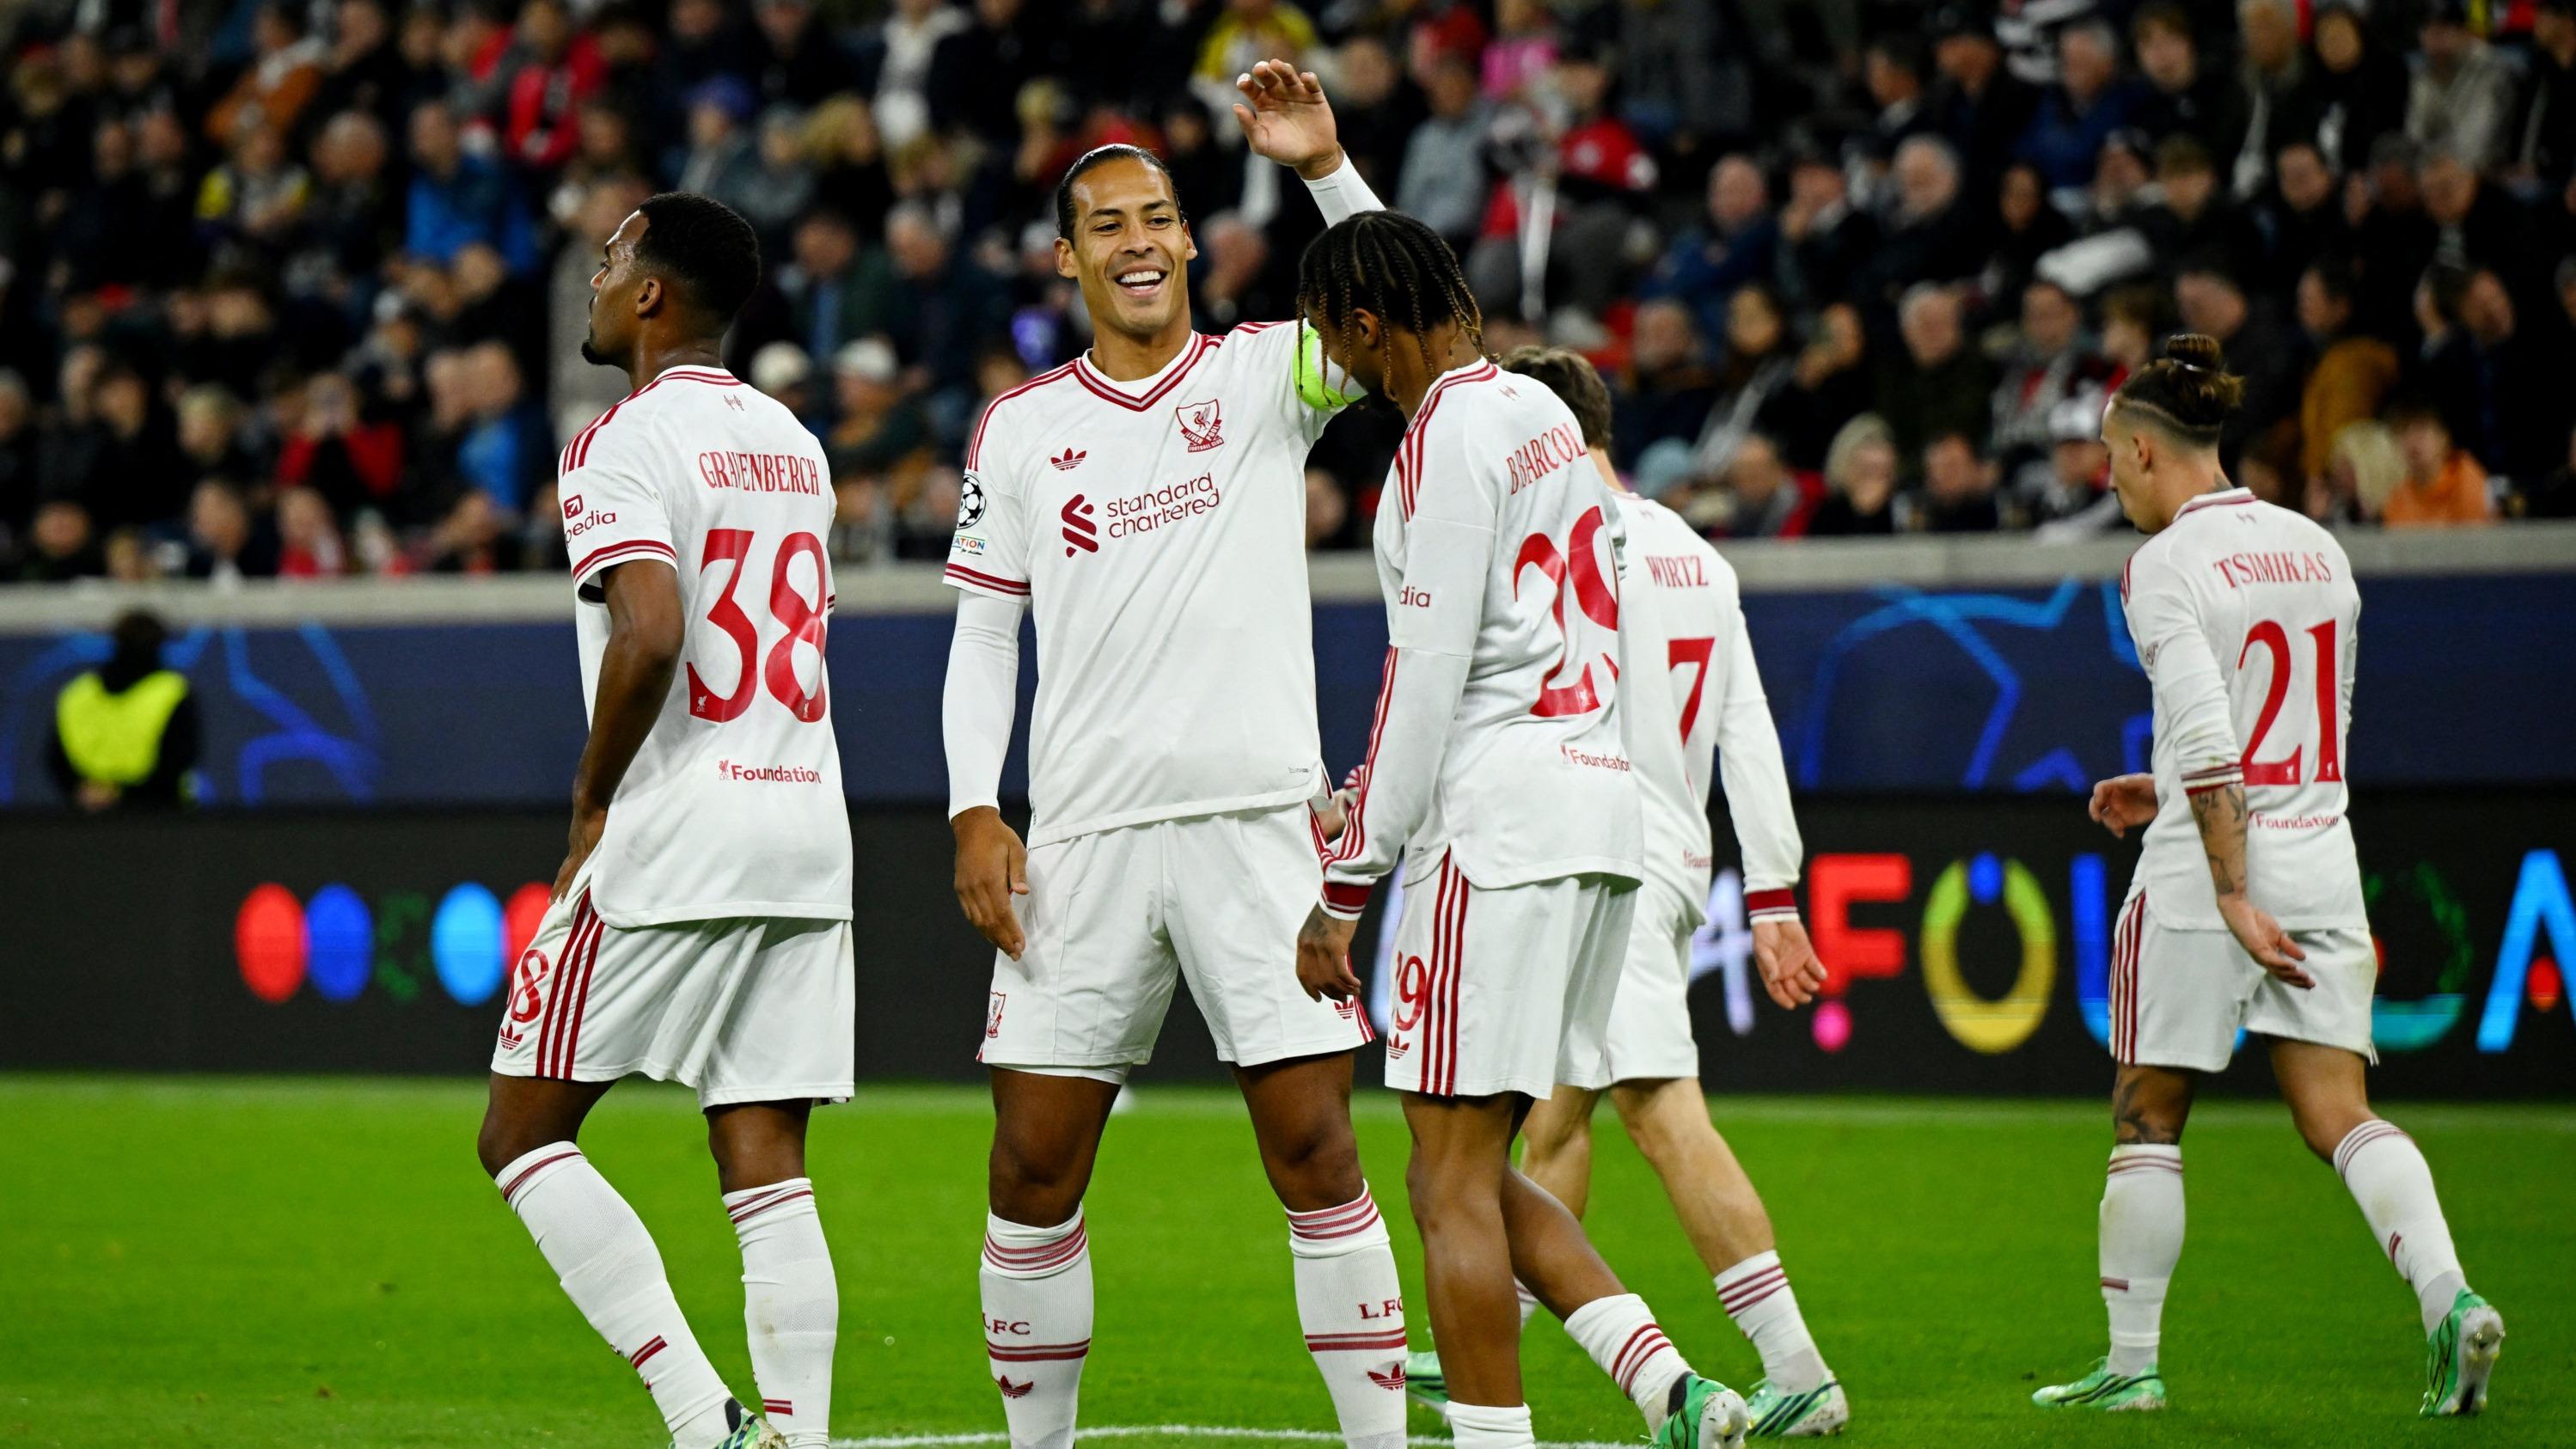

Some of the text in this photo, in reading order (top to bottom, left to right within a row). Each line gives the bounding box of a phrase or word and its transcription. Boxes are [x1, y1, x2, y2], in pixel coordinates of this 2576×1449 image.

[1506, 423, 1588, 495] BBARCOL
[1107, 472, 1214, 517] standard
[1109, 488, 1220, 538] chartered
[1645, 555, 1709, 587] WIRTZ
[2212, 552, 2332, 588] TSIMIKAS
[687, 529, 826, 723] 38
[1513, 505, 1619, 718] 29
[1667, 636, 1716, 750] 7
[2238, 618, 2343, 786] 21
[731, 765, 822, 784] Foundation
[1569, 749, 1631, 772] Foundato
